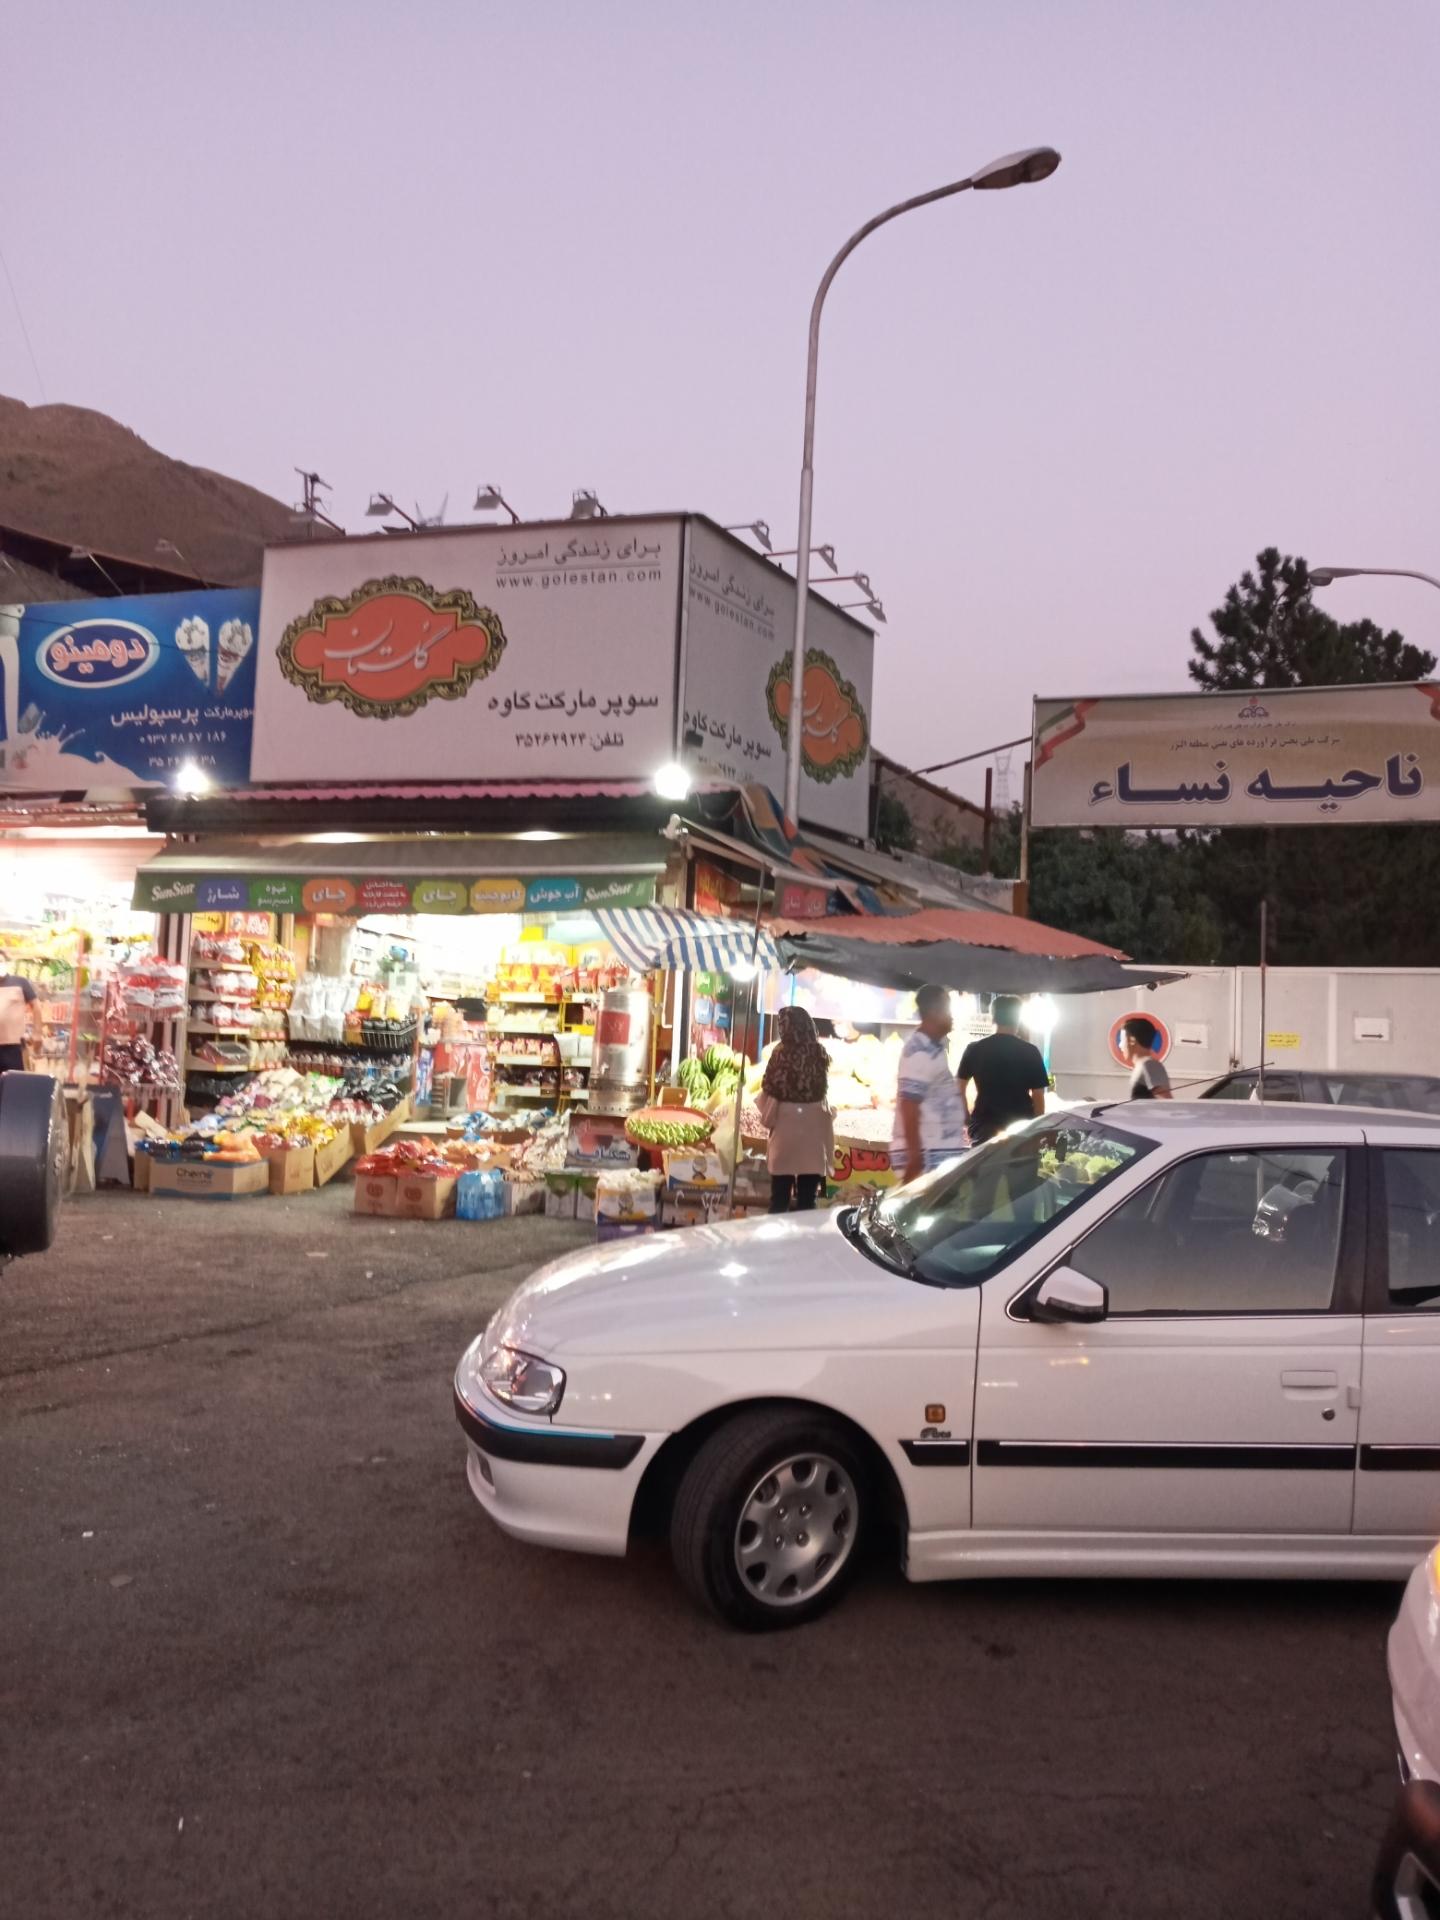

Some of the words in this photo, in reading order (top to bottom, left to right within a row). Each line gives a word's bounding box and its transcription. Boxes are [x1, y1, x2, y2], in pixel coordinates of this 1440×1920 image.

[497, 542, 549, 566] امروز
[554, 539, 611, 565] زندگی
[617, 537, 661, 560] برای
[496, 570, 662, 589] www.golestan.com
[323, 618, 455, 676] گلستان
[111, 703, 200, 728] پرسپولیس
[488, 690, 531, 718] کاوه
[1089, 758, 1233, 806] نساء
[1246, 752, 1424, 813] ناحیه
[151, 880, 196, 902] SunStar
[207, 886, 240, 904] شارژ
[312, 886, 346, 904] چای
[422, 886, 457, 905] چای
[584, 881, 634, 903] SunStar
